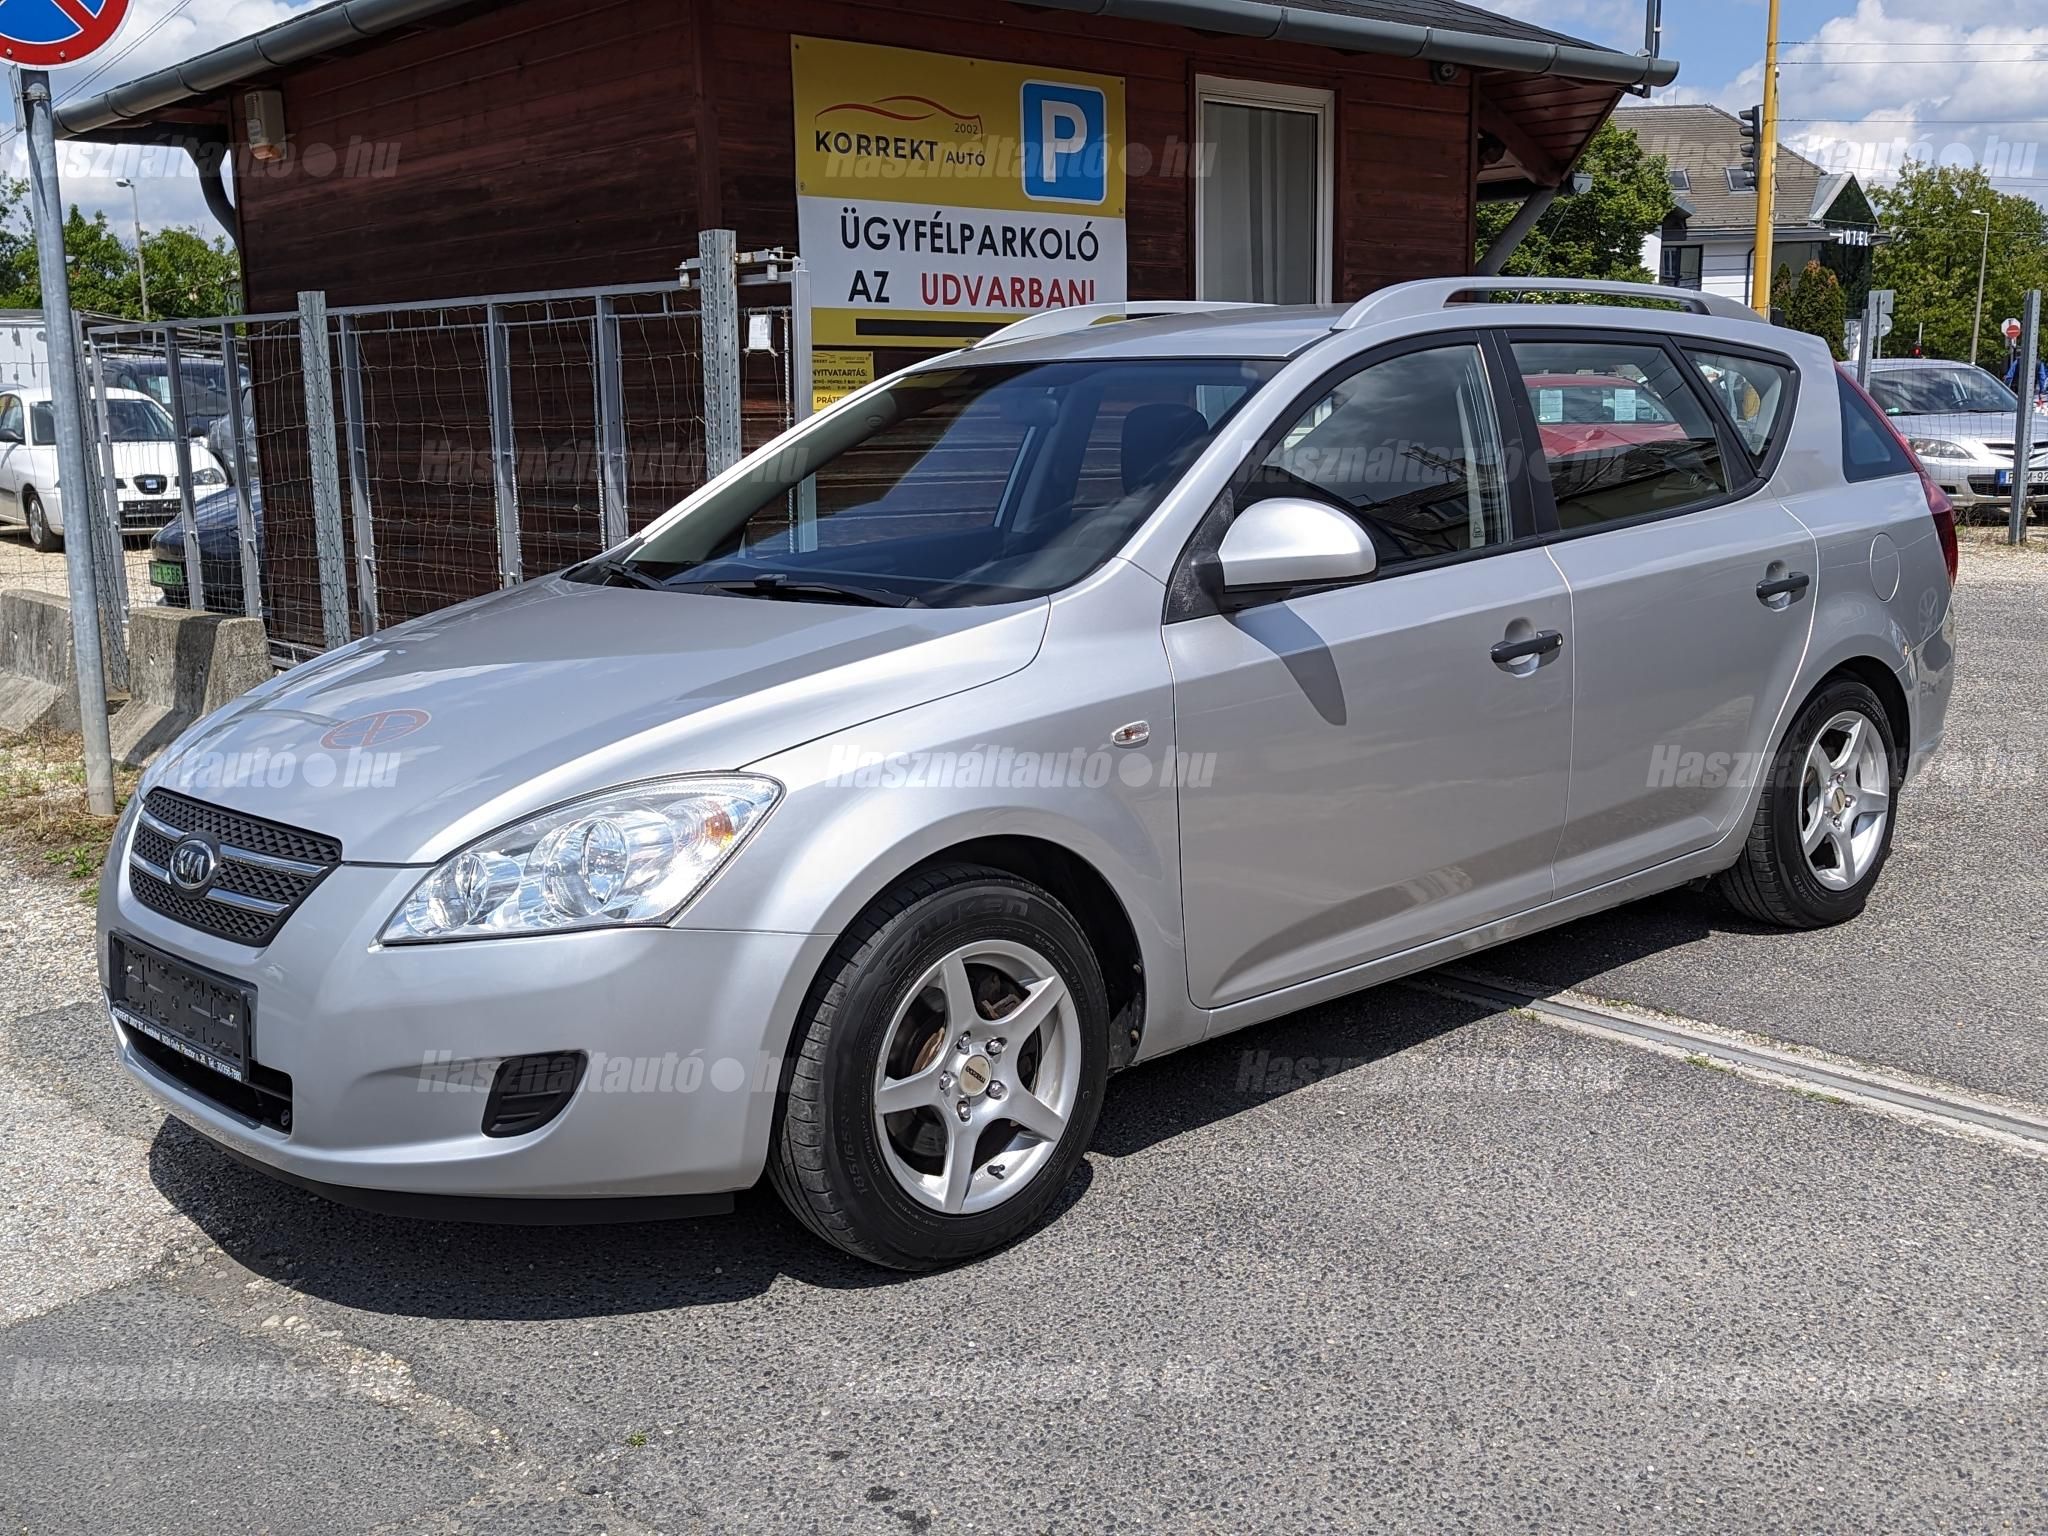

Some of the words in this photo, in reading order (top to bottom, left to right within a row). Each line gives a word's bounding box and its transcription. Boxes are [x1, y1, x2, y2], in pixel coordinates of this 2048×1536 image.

[954, 122, 979, 135] 2002
[1041, 99, 1088, 183] P
[815, 129, 939, 162] KORREKT
[945, 151, 986, 167] AUTÓ
[840, 206, 1099, 262] ÜGYFÉLPARKOLÓ
[848, 270, 890, 303] AZ
